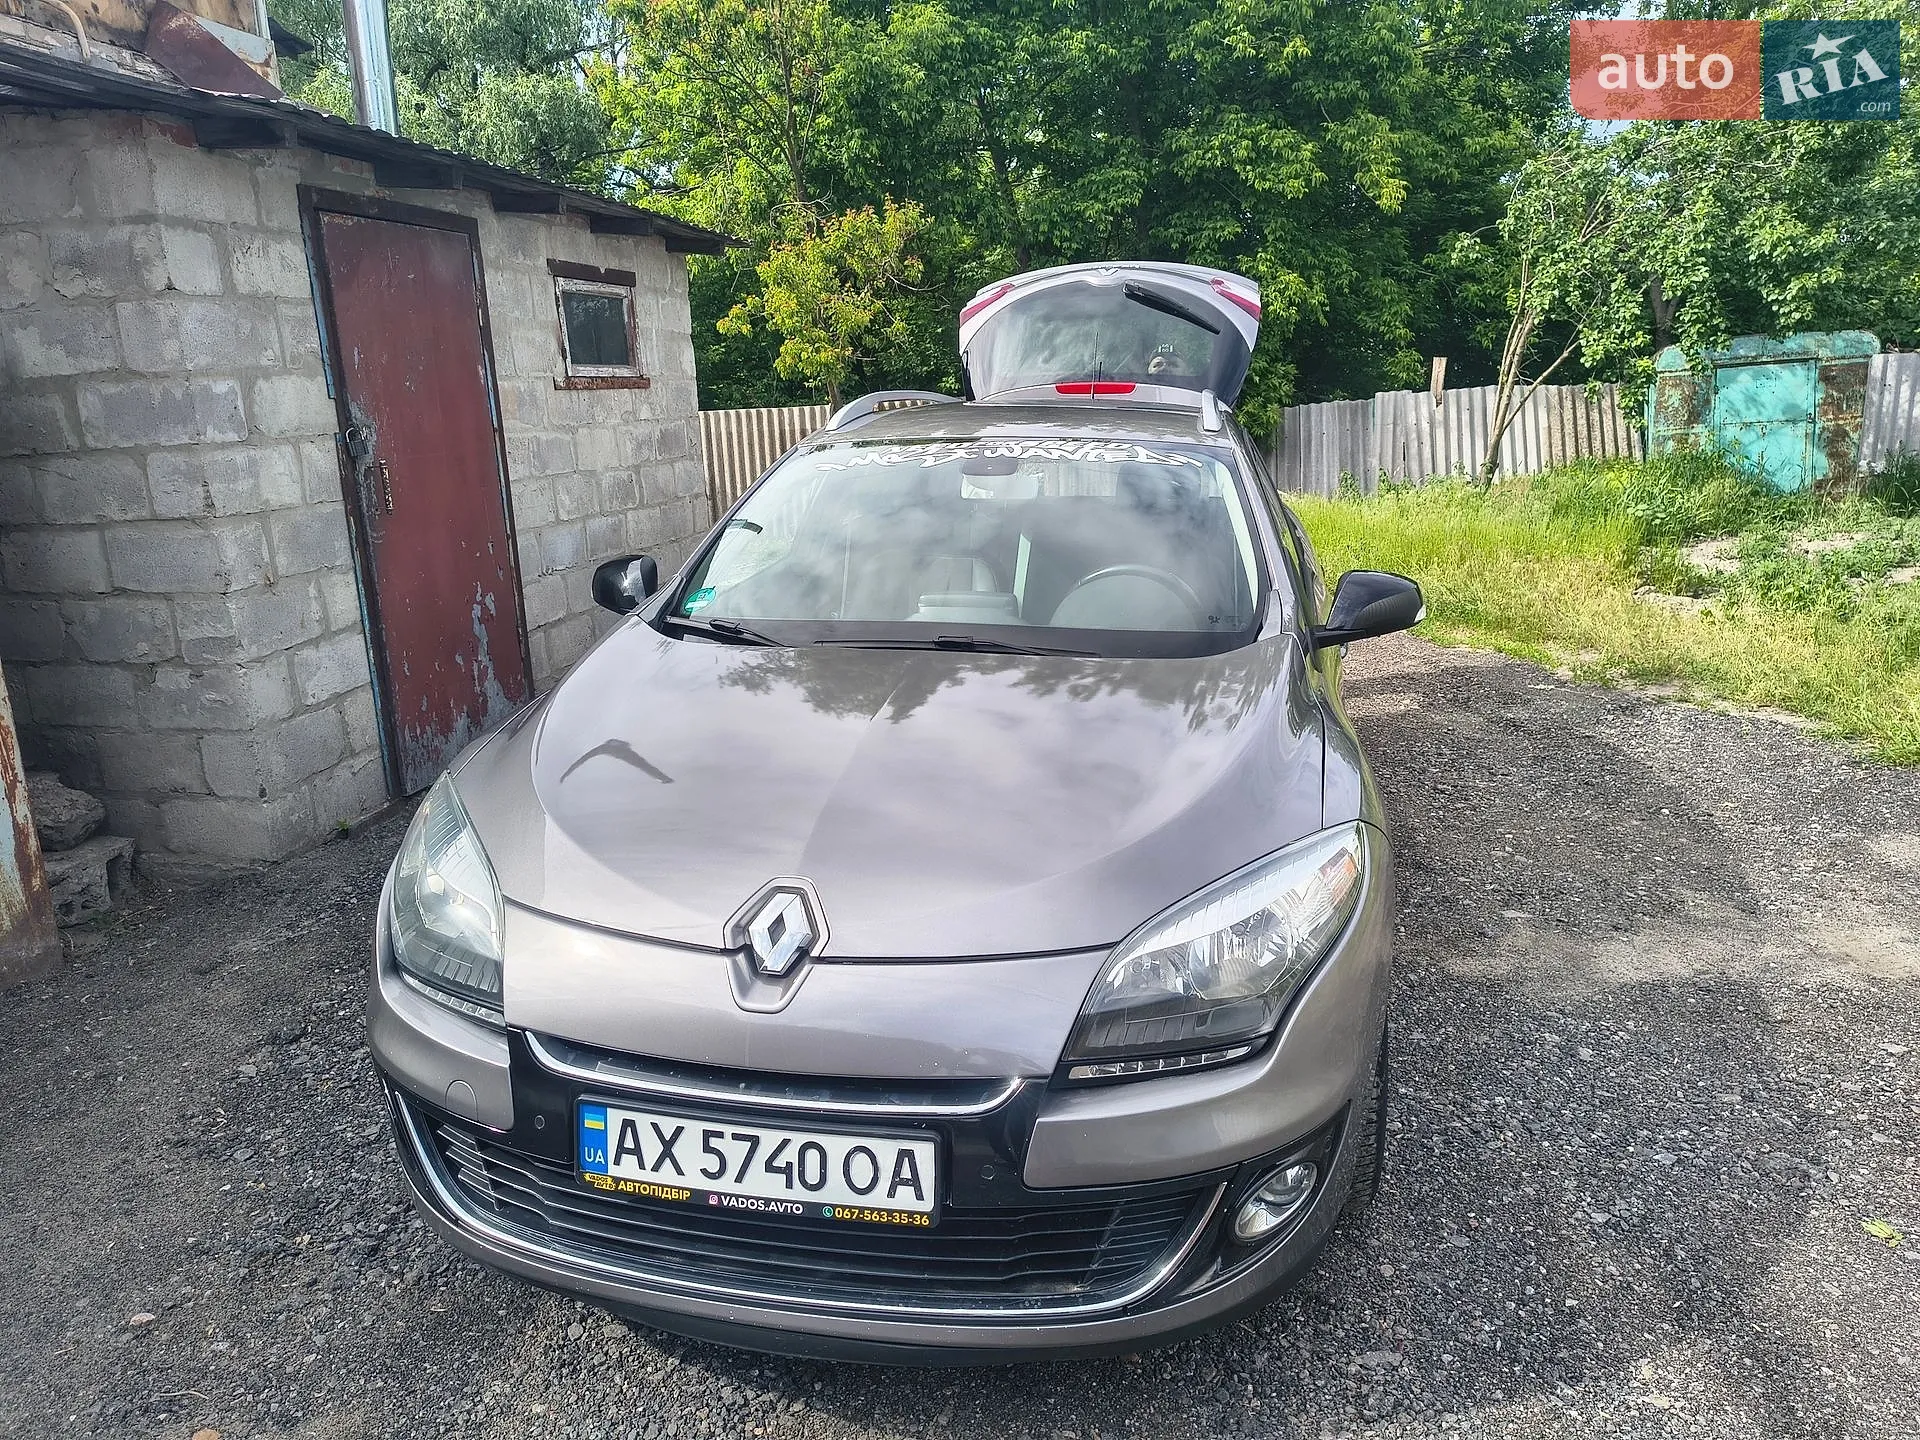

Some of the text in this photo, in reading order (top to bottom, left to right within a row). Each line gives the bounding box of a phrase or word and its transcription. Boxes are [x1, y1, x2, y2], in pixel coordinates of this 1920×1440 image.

[982, 444, 1203, 467] WANTED
[584, 1147, 606, 1165] UA
[613, 1118, 925, 1201] AX 5740 OA
[617, 1180, 691, 1201] АВТОПІДБІР
[721, 1196, 803, 1215] VADOS.AVTO
[835, 1207, 930, 1226] 067-563-35-36
